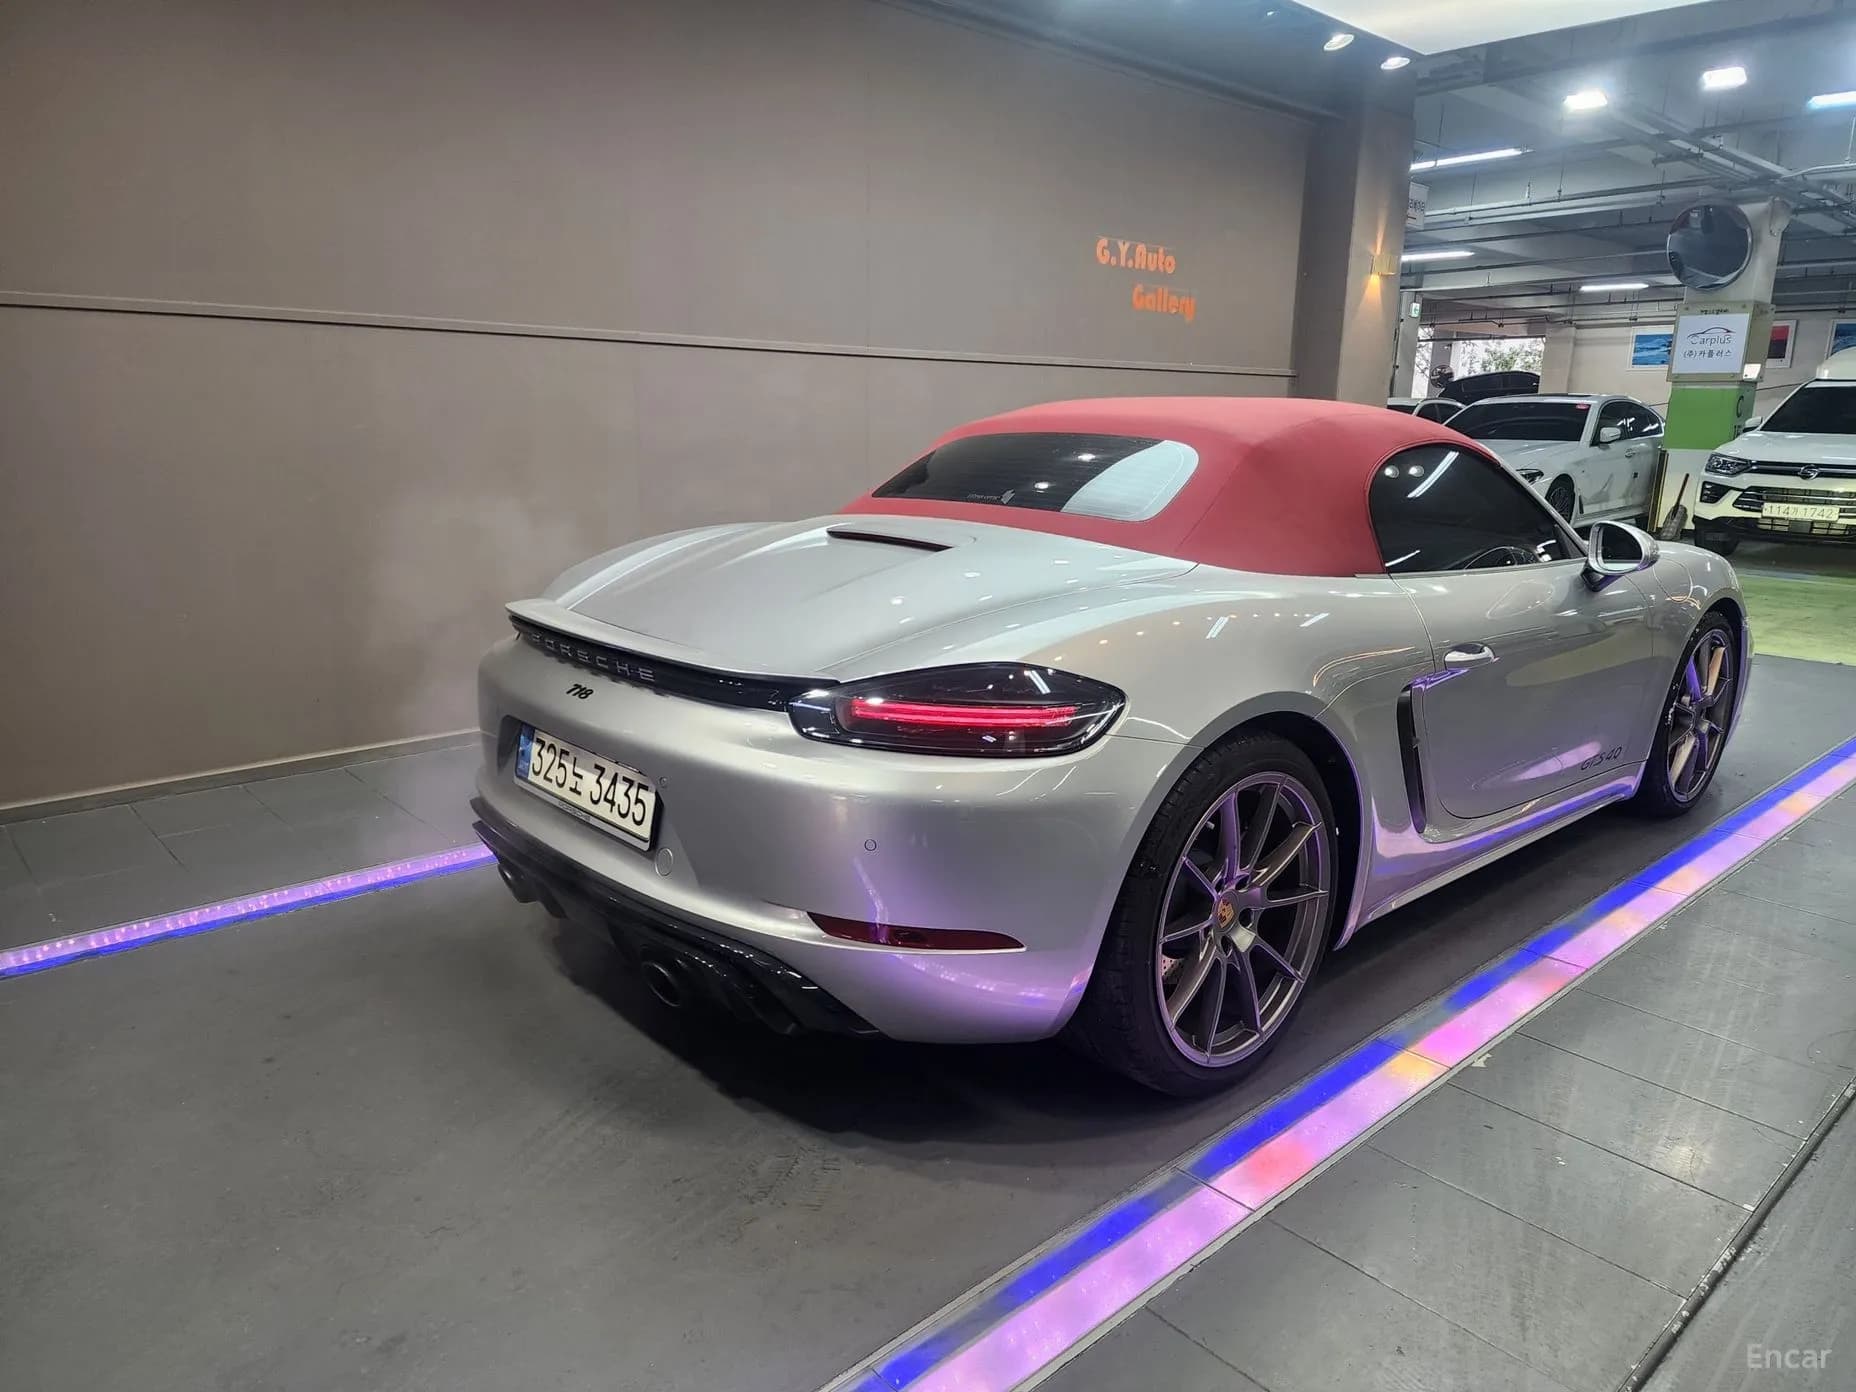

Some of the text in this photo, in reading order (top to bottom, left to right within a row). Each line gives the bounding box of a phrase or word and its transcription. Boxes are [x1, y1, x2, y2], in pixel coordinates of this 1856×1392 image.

[1096, 237, 1176, 274] G.Y.Auto
[1132, 284, 1196, 321] Gallery
[1690, 334, 1733, 347] Carplus
[530, 631, 656, 682] PORSCHE
[566, 683, 595, 700] 718
[532, 737, 650, 827] 325노 3435
